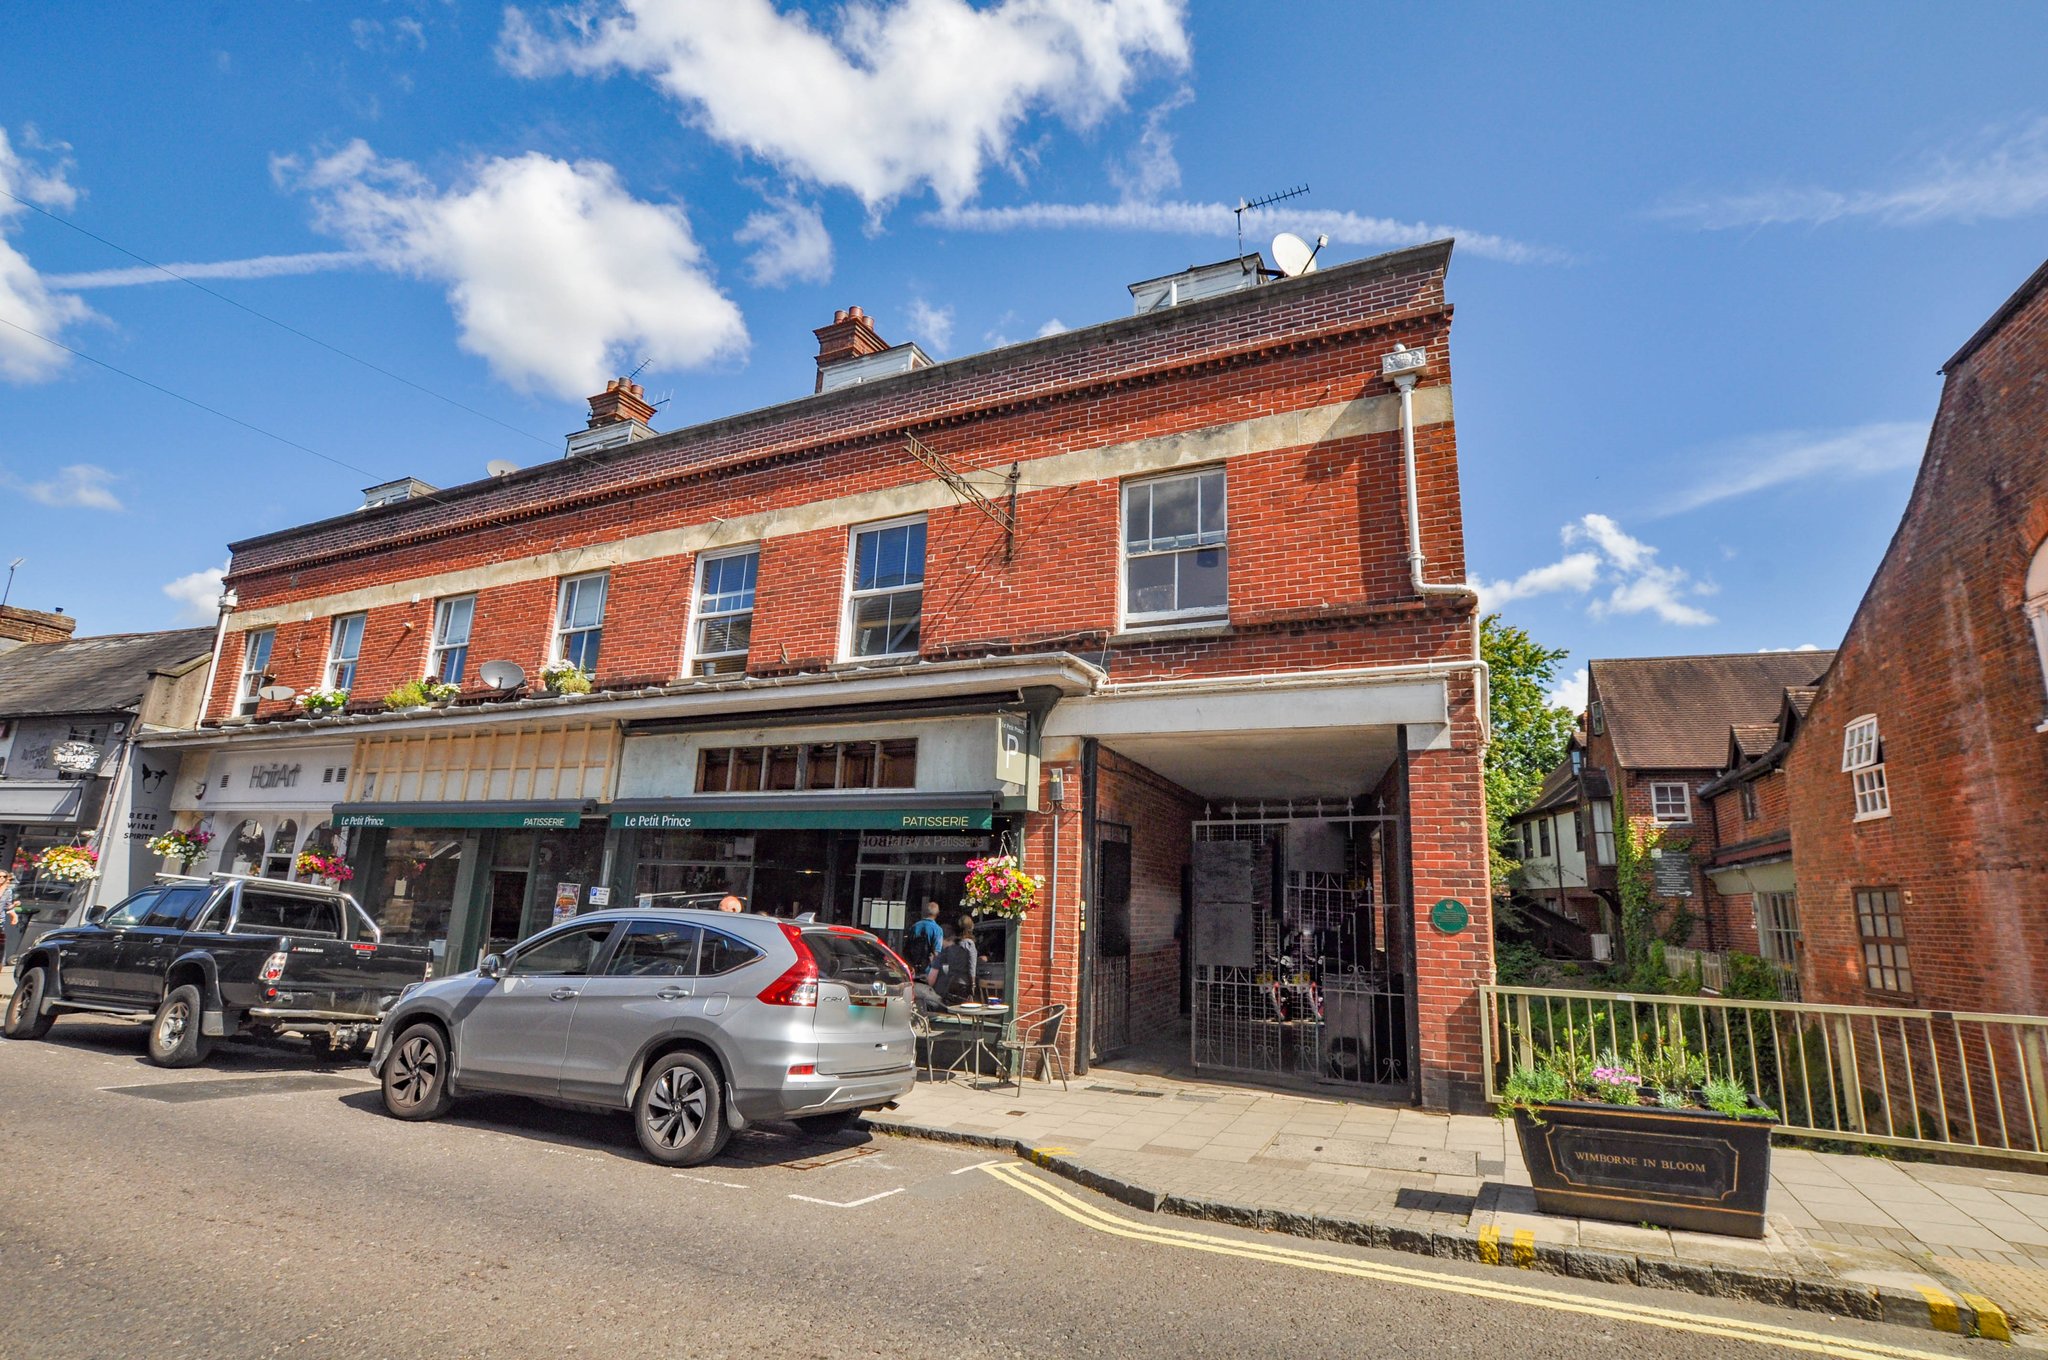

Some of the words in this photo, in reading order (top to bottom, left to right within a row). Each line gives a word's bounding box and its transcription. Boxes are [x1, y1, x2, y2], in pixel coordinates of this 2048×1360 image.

[1006, 733, 1019, 768] P
[129, 812, 158, 821] BEER
[341, 816, 349, 825] Le
[350, 815, 364, 825] Petit
[364, 815, 384, 826] Prince
[523, 817, 565, 827] PATISSERIE
[625, 816, 636, 827] Le
[638, 814, 659, 827] Petit
[661, 814, 691, 827] Prince
[902, 816, 969, 827] PATISSERIE
[127, 822, 156, 831] WINE
[1574, 1151, 1638, 1166] WIMBORNE
[1643, 1158, 1657, 1168] IN
[1661, 1160, 1706, 1173] BLOOM
